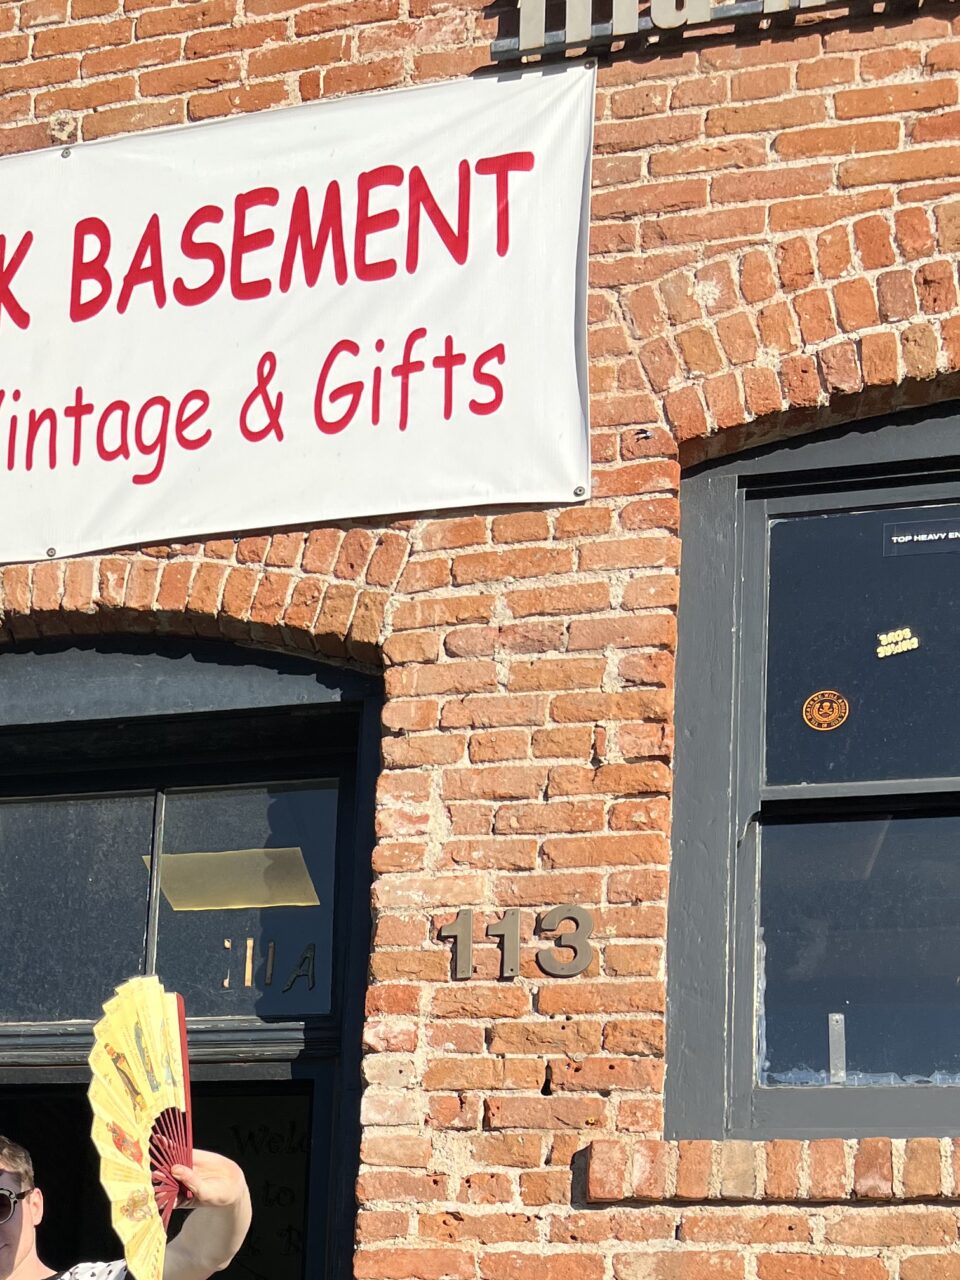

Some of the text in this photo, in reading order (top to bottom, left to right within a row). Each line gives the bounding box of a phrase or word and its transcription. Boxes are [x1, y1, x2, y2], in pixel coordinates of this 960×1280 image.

[69, 151, 535, 323] BASEMENT
[239, 351, 284, 442] &
[314, 327, 506, 435] Gifts
[891, 535, 913, 544] TOP
[913, 532, 947, 542] HEAVY
[441, 904, 594, 979] 113
